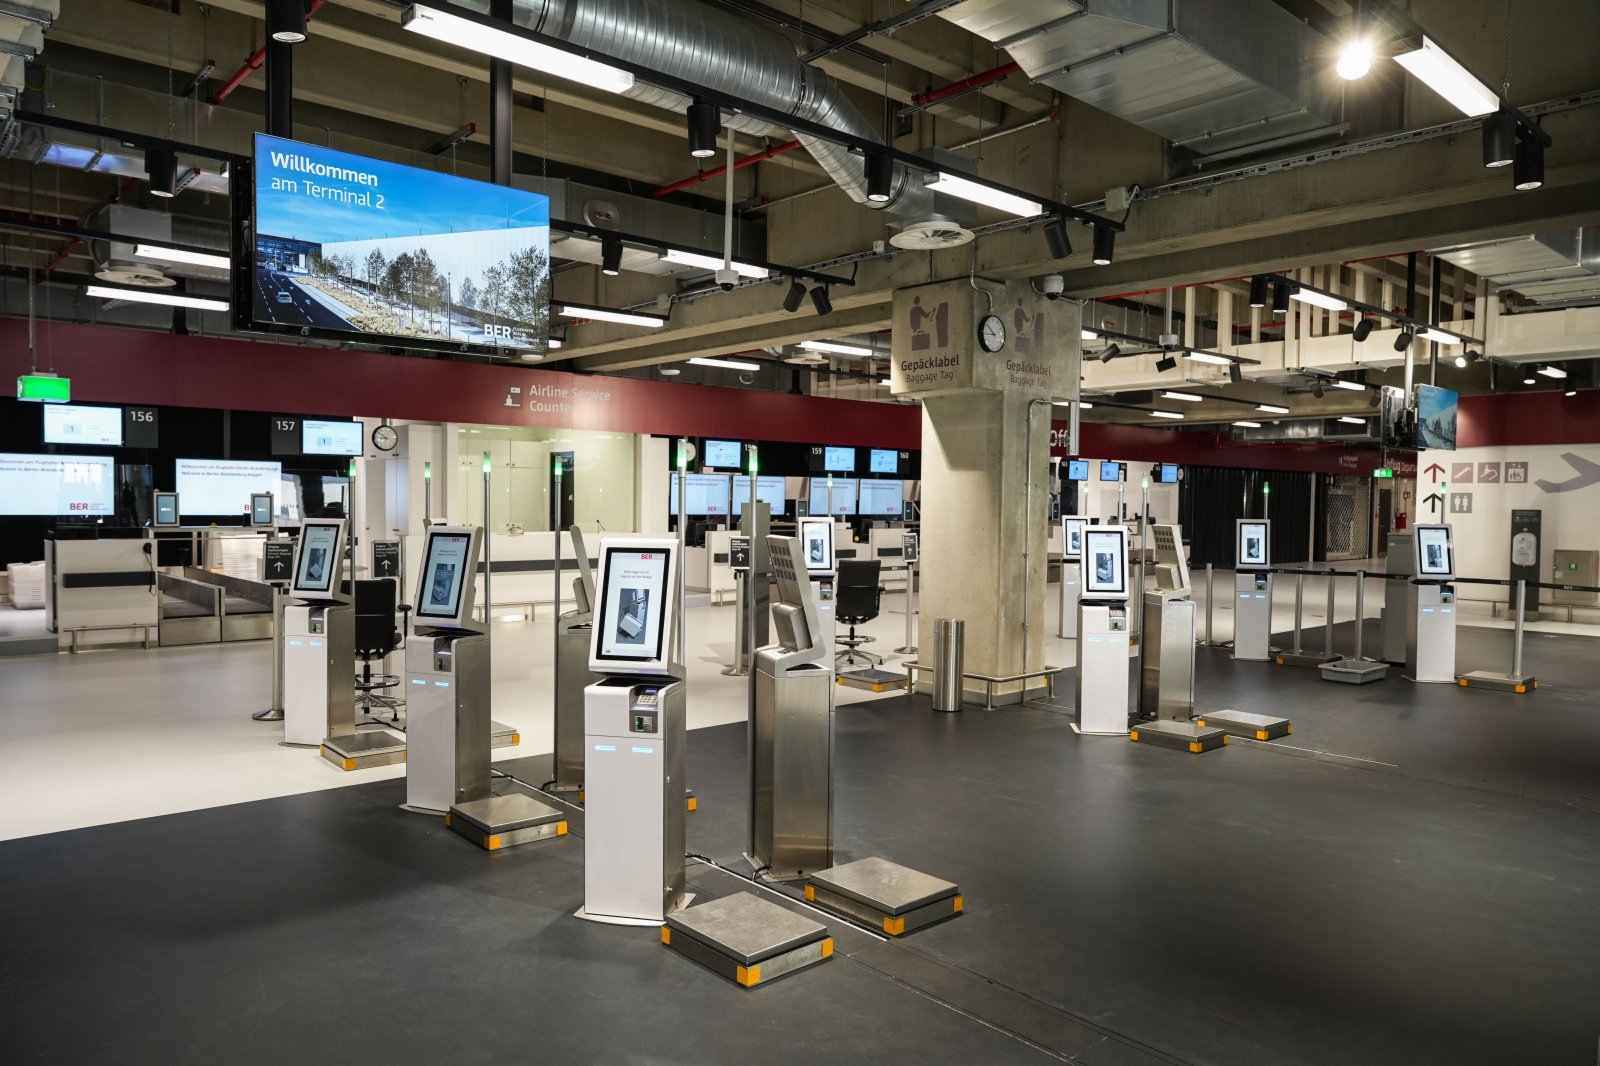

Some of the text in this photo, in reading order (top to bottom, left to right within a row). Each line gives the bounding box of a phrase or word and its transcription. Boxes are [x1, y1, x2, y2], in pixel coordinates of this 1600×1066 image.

[270, 151, 378, 187] Willkommen
[271, 177, 385, 209] am Terminal 2
[484, 324, 512, 339] BER
[901, 354, 960, 372] Gepäcklabel
[1006, 359, 1052, 377] Gepäcklabel
[906, 370, 954, 385] Baggage Tag
[1010, 374, 1047, 389] Baggage Tag
[529, 385, 611, 401] Airline Service
[529, 400, 575, 413] Counte
[130, 411, 154, 422] 156
[276, 421, 295, 431] 157
[811, 447, 823, 455] 159
[69, 503, 89, 511] BER
